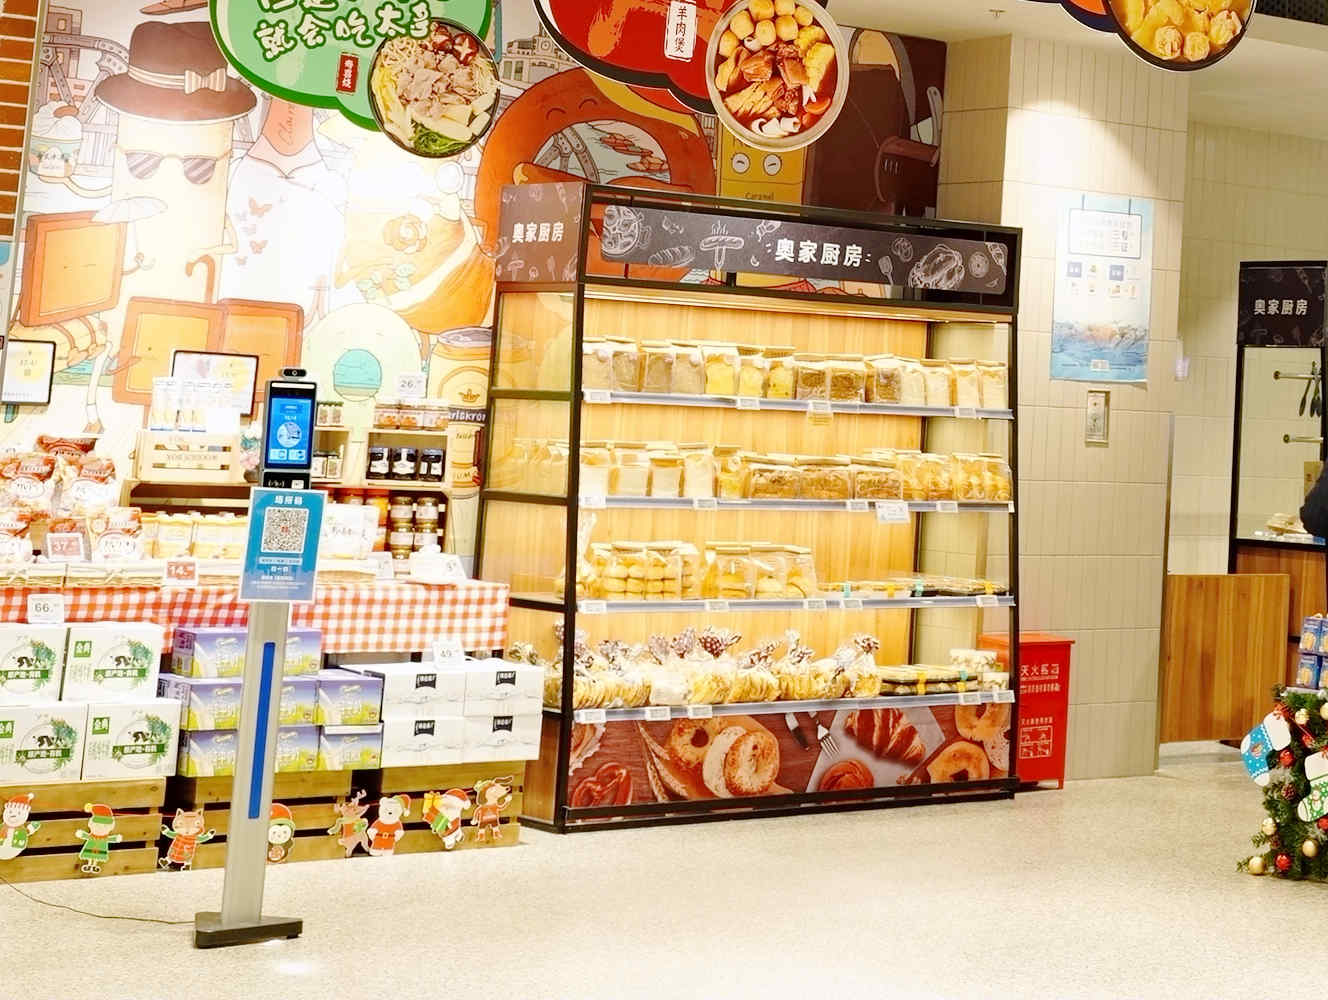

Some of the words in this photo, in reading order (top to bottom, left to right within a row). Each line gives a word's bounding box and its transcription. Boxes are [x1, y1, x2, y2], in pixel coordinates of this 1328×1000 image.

[253, 1, 431, 61] 就会吃太多
[674, 6, 688, 54] 羊肉煲
[512, 221, 564, 244] 奥家厨房
[775, 238, 865, 269] 奥家厨房
[1253, 297, 1309, 316] 奥家厨房
